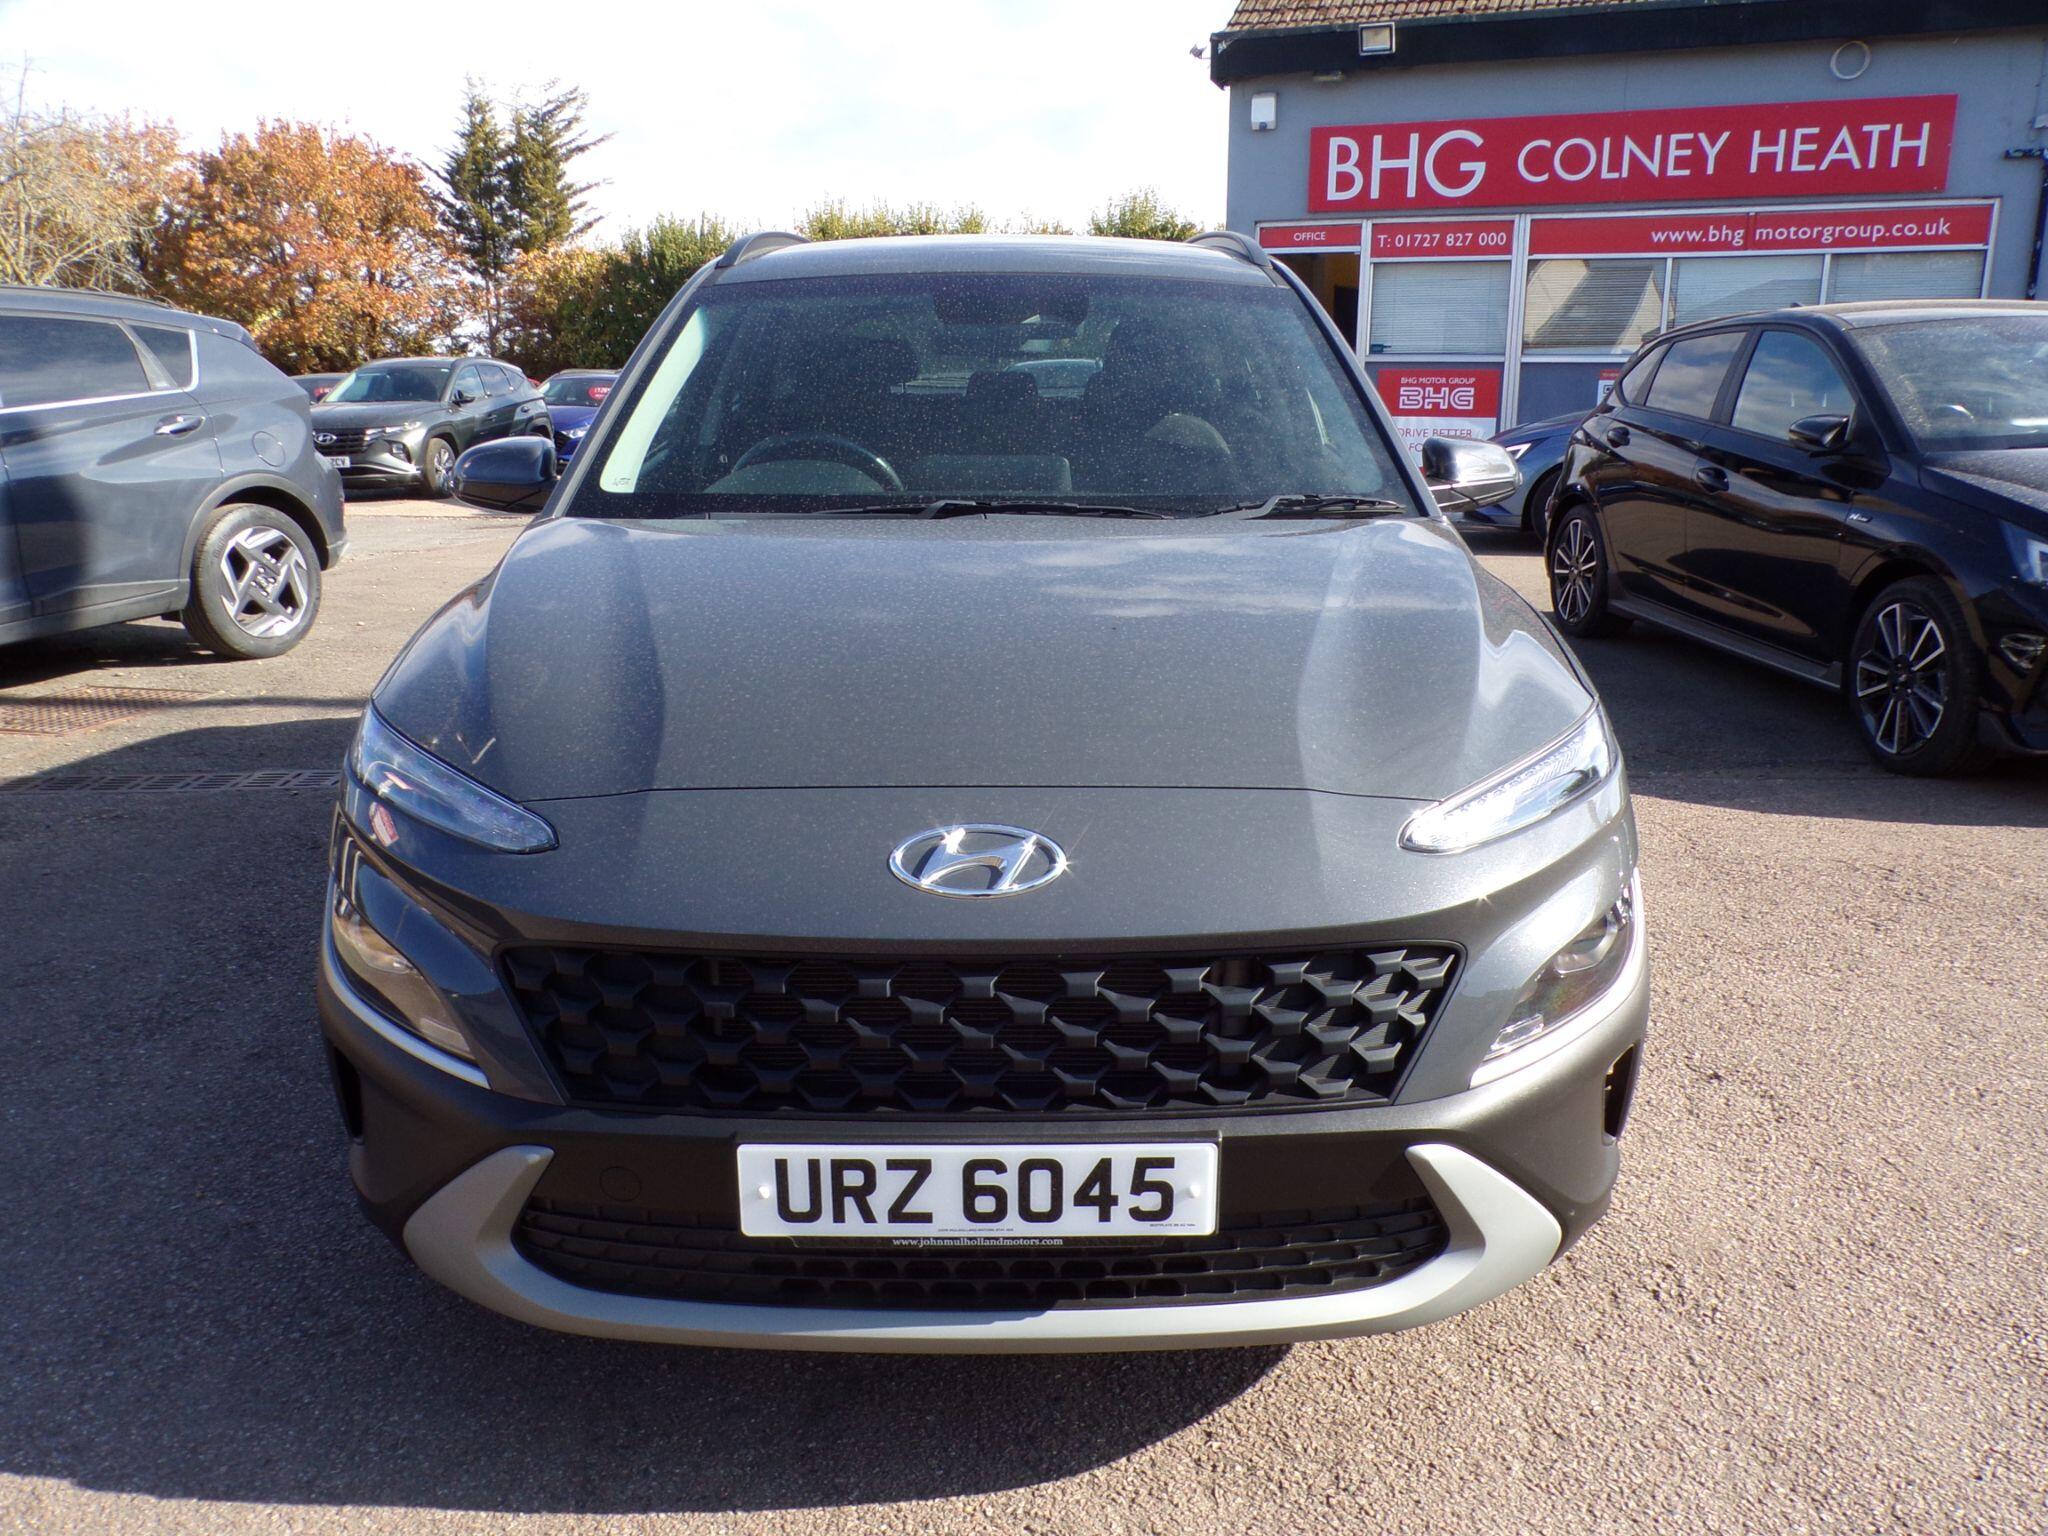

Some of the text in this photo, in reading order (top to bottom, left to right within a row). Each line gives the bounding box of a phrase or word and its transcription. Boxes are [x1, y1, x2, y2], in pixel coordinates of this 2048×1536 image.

[1326, 122, 1931, 201] BHG COLNEY HEATH
[1293, 231, 1326, 241] OFFICE
[1651, 217, 1951, 246] www.bhg motorgroup.co.uk
[1377, 232, 1507, 248] T: 01727 827 000
[1448, 377, 1476, 385] GROUP
[1399, 387, 1475, 410] BHG
[1397, 428, 1473, 438] DRIVE BETTER
[774, 1156, 1176, 1223] URZ 6045
[892, 1237, 1064, 1249] www.johnmulhollandmotors.com
